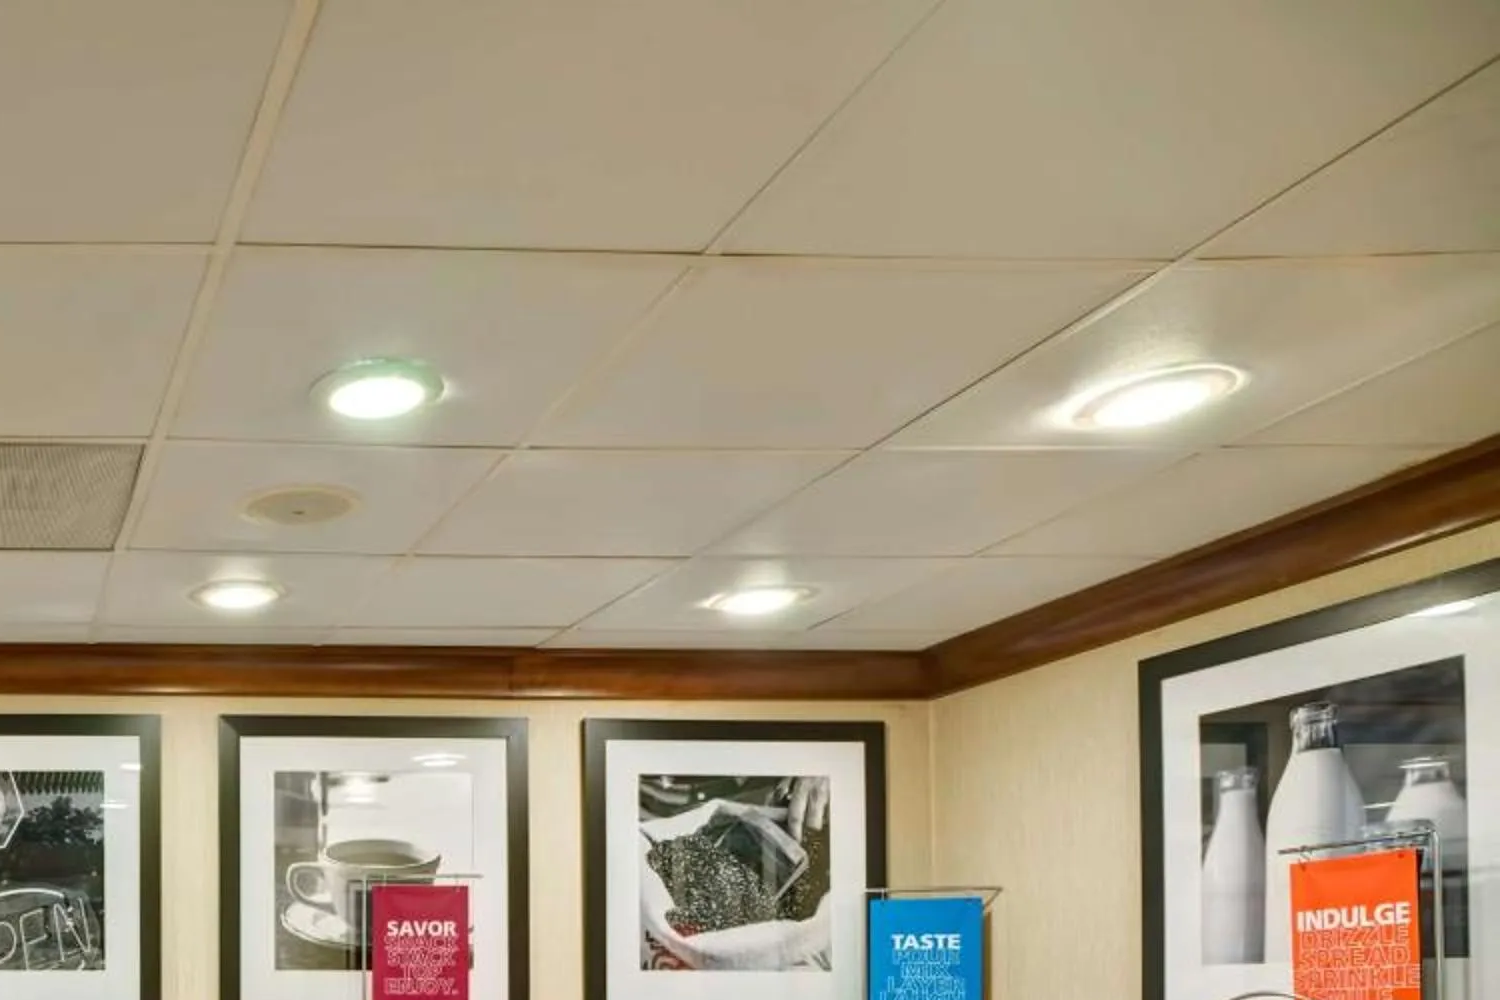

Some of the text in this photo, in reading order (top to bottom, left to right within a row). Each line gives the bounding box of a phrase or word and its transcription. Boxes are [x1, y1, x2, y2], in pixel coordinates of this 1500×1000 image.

[387, 921, 457, 936] SAVOR
[1297, 902, 1411, 932] INDULGE
[891, 933, 960, 949] TASTE
[1300, 925, 1409, 951] DRIZZLE
[1300, 945, 1410, 970] SPREAD
[1294, 963, 1420, 990] SPRINKLE
